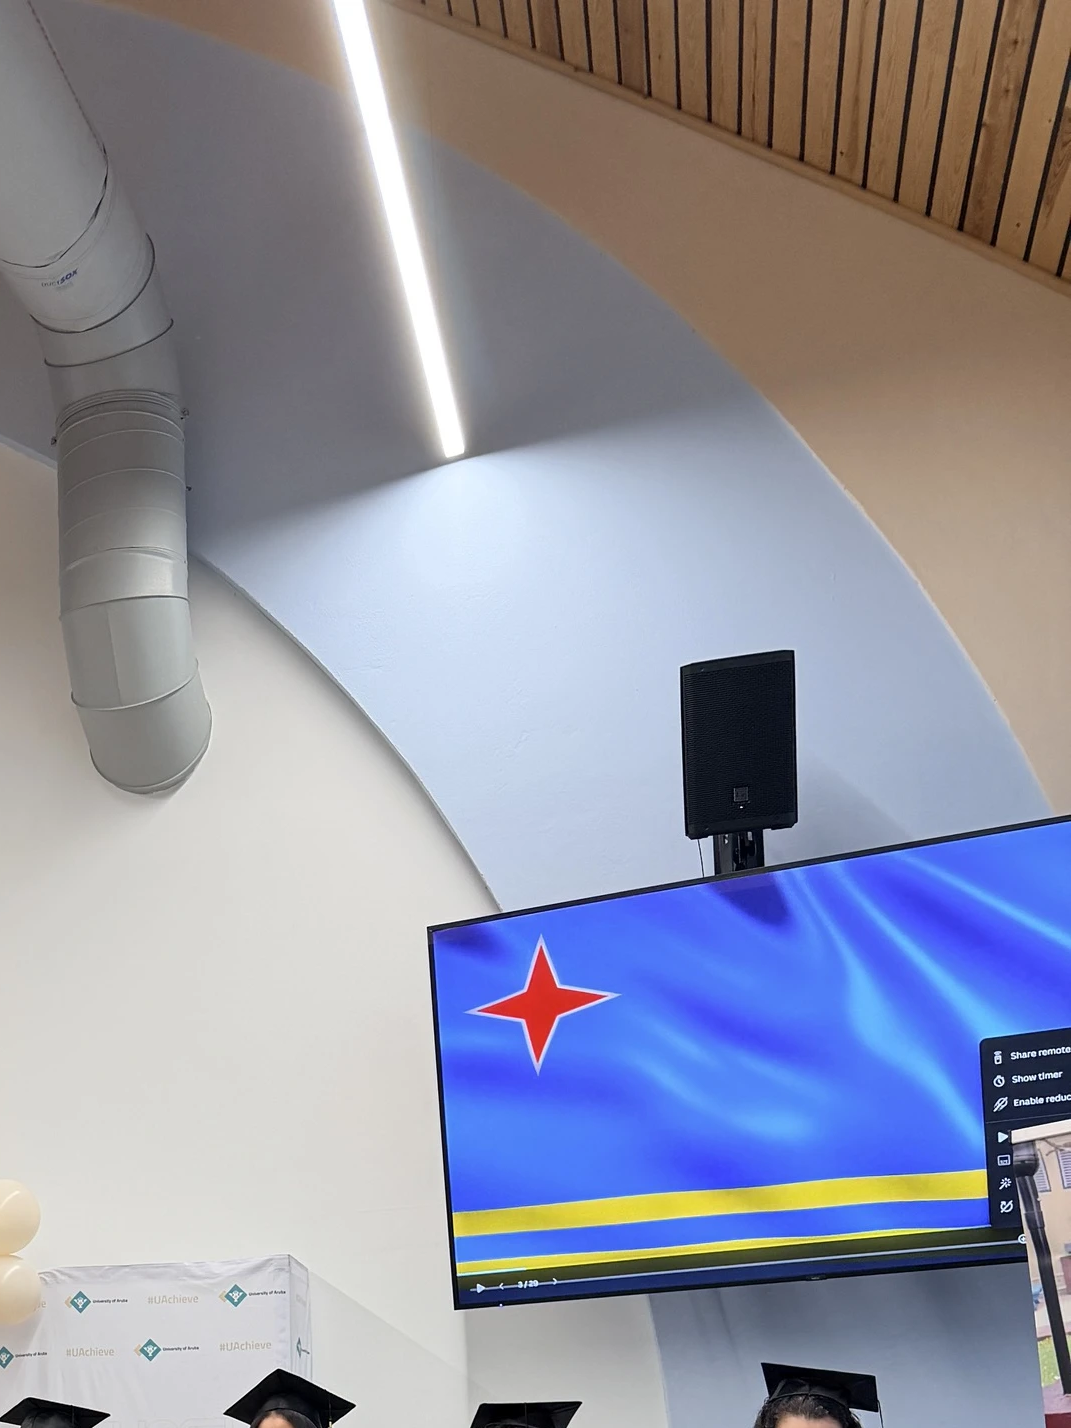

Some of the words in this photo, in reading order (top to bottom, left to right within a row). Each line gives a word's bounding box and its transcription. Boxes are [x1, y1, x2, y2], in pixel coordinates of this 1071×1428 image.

[1010, 1050, 1037, 1060] Share
[1038, 1046, 1071, 1057] remote
[1011, 1074, 1037, 1084] Show
[1038, 1071, 1063, 1081] timer
[1013, 1096, 1044, 1107] Enable
[1045, 1093, 1071, 1103] reduc
[147, 1294, 199, 1305] #UAchieve
[219, 1340, 272, 1352] #UAchieve
[66, 1347, 115, 1358] #UAchieve
